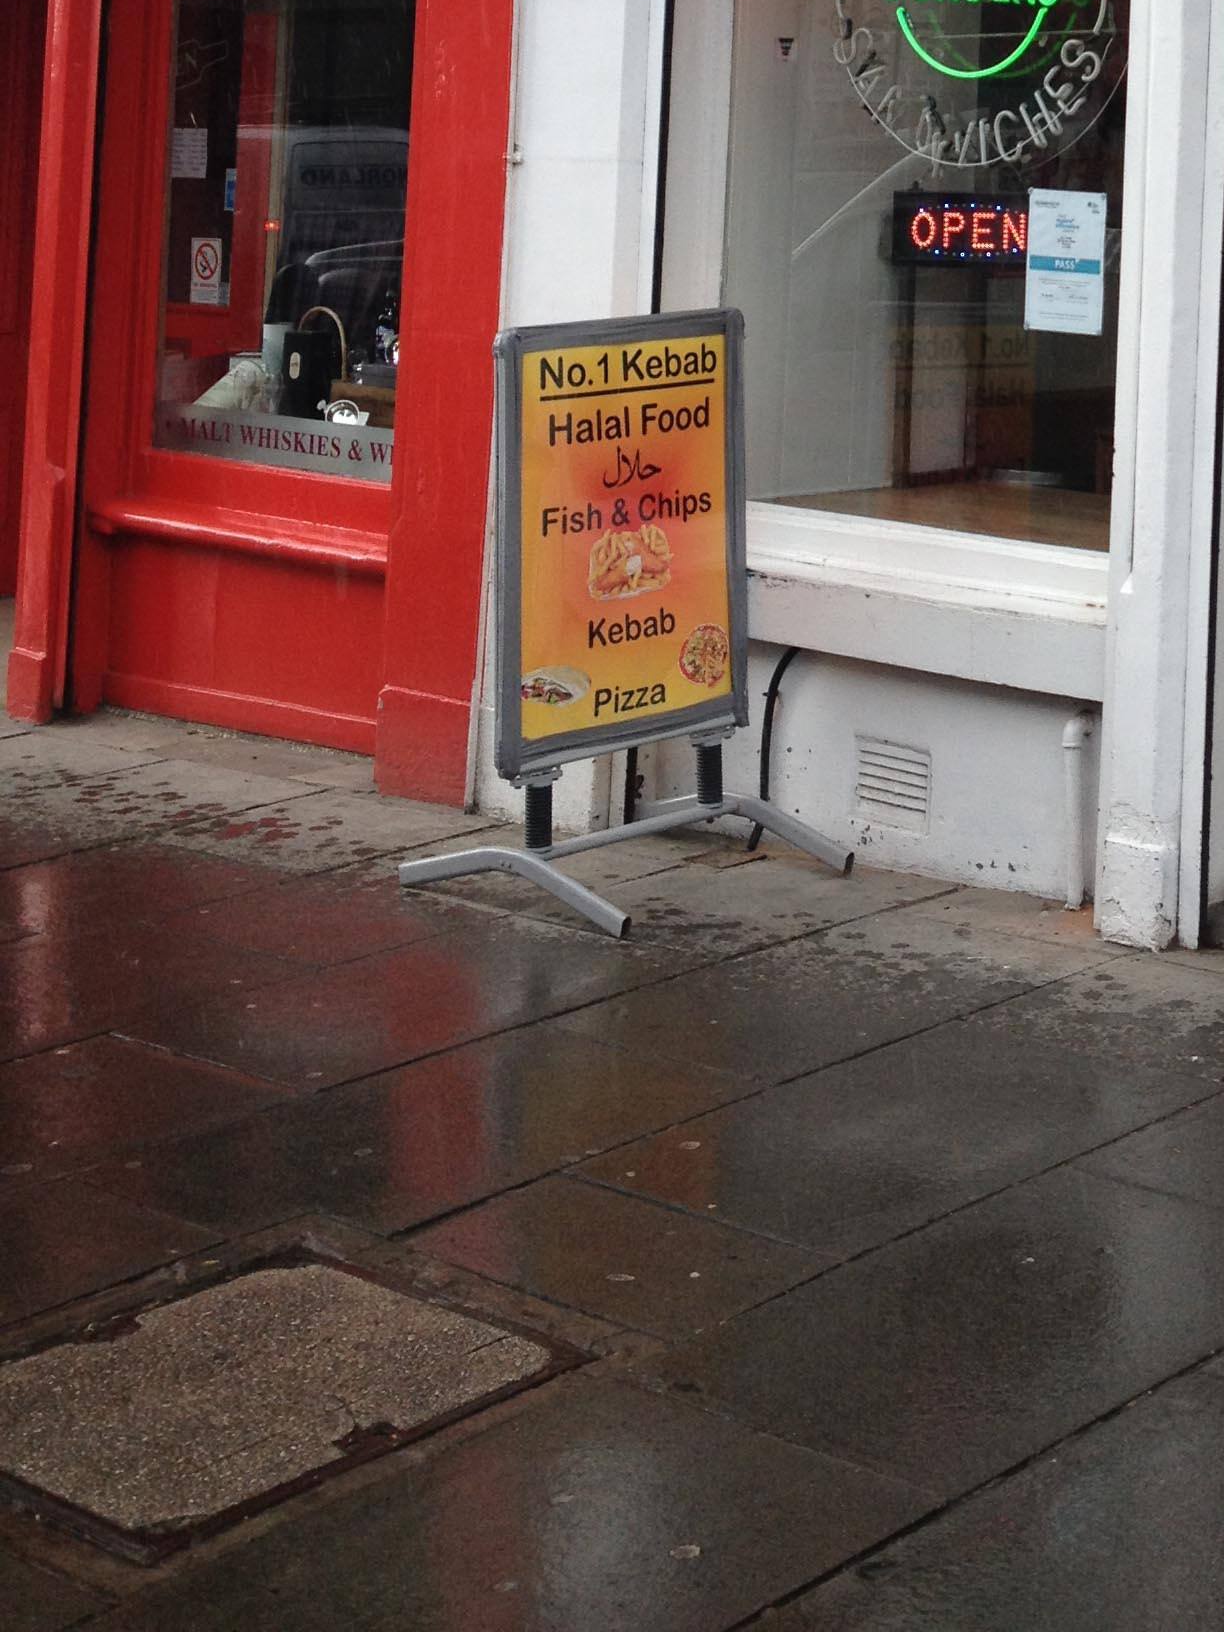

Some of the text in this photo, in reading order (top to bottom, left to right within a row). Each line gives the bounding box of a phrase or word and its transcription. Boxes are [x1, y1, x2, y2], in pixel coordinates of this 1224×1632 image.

[911, 211, 1027, 250] OPEN
[540, 342, 716, 390] No.1 Kebab
[180, 418, 233, 443] MALT
[240, 425, 341, 458] WHISKIES
[348, 439, 363, 461] &
[549, 396, 710, 447] Halal Food
[603, 446, 662, 488] حلال
[542, 489, 712, 537] Fish & Chips
[588, 608, 676, 649] Kebab
[593, 683, 666, 717] Pizza
